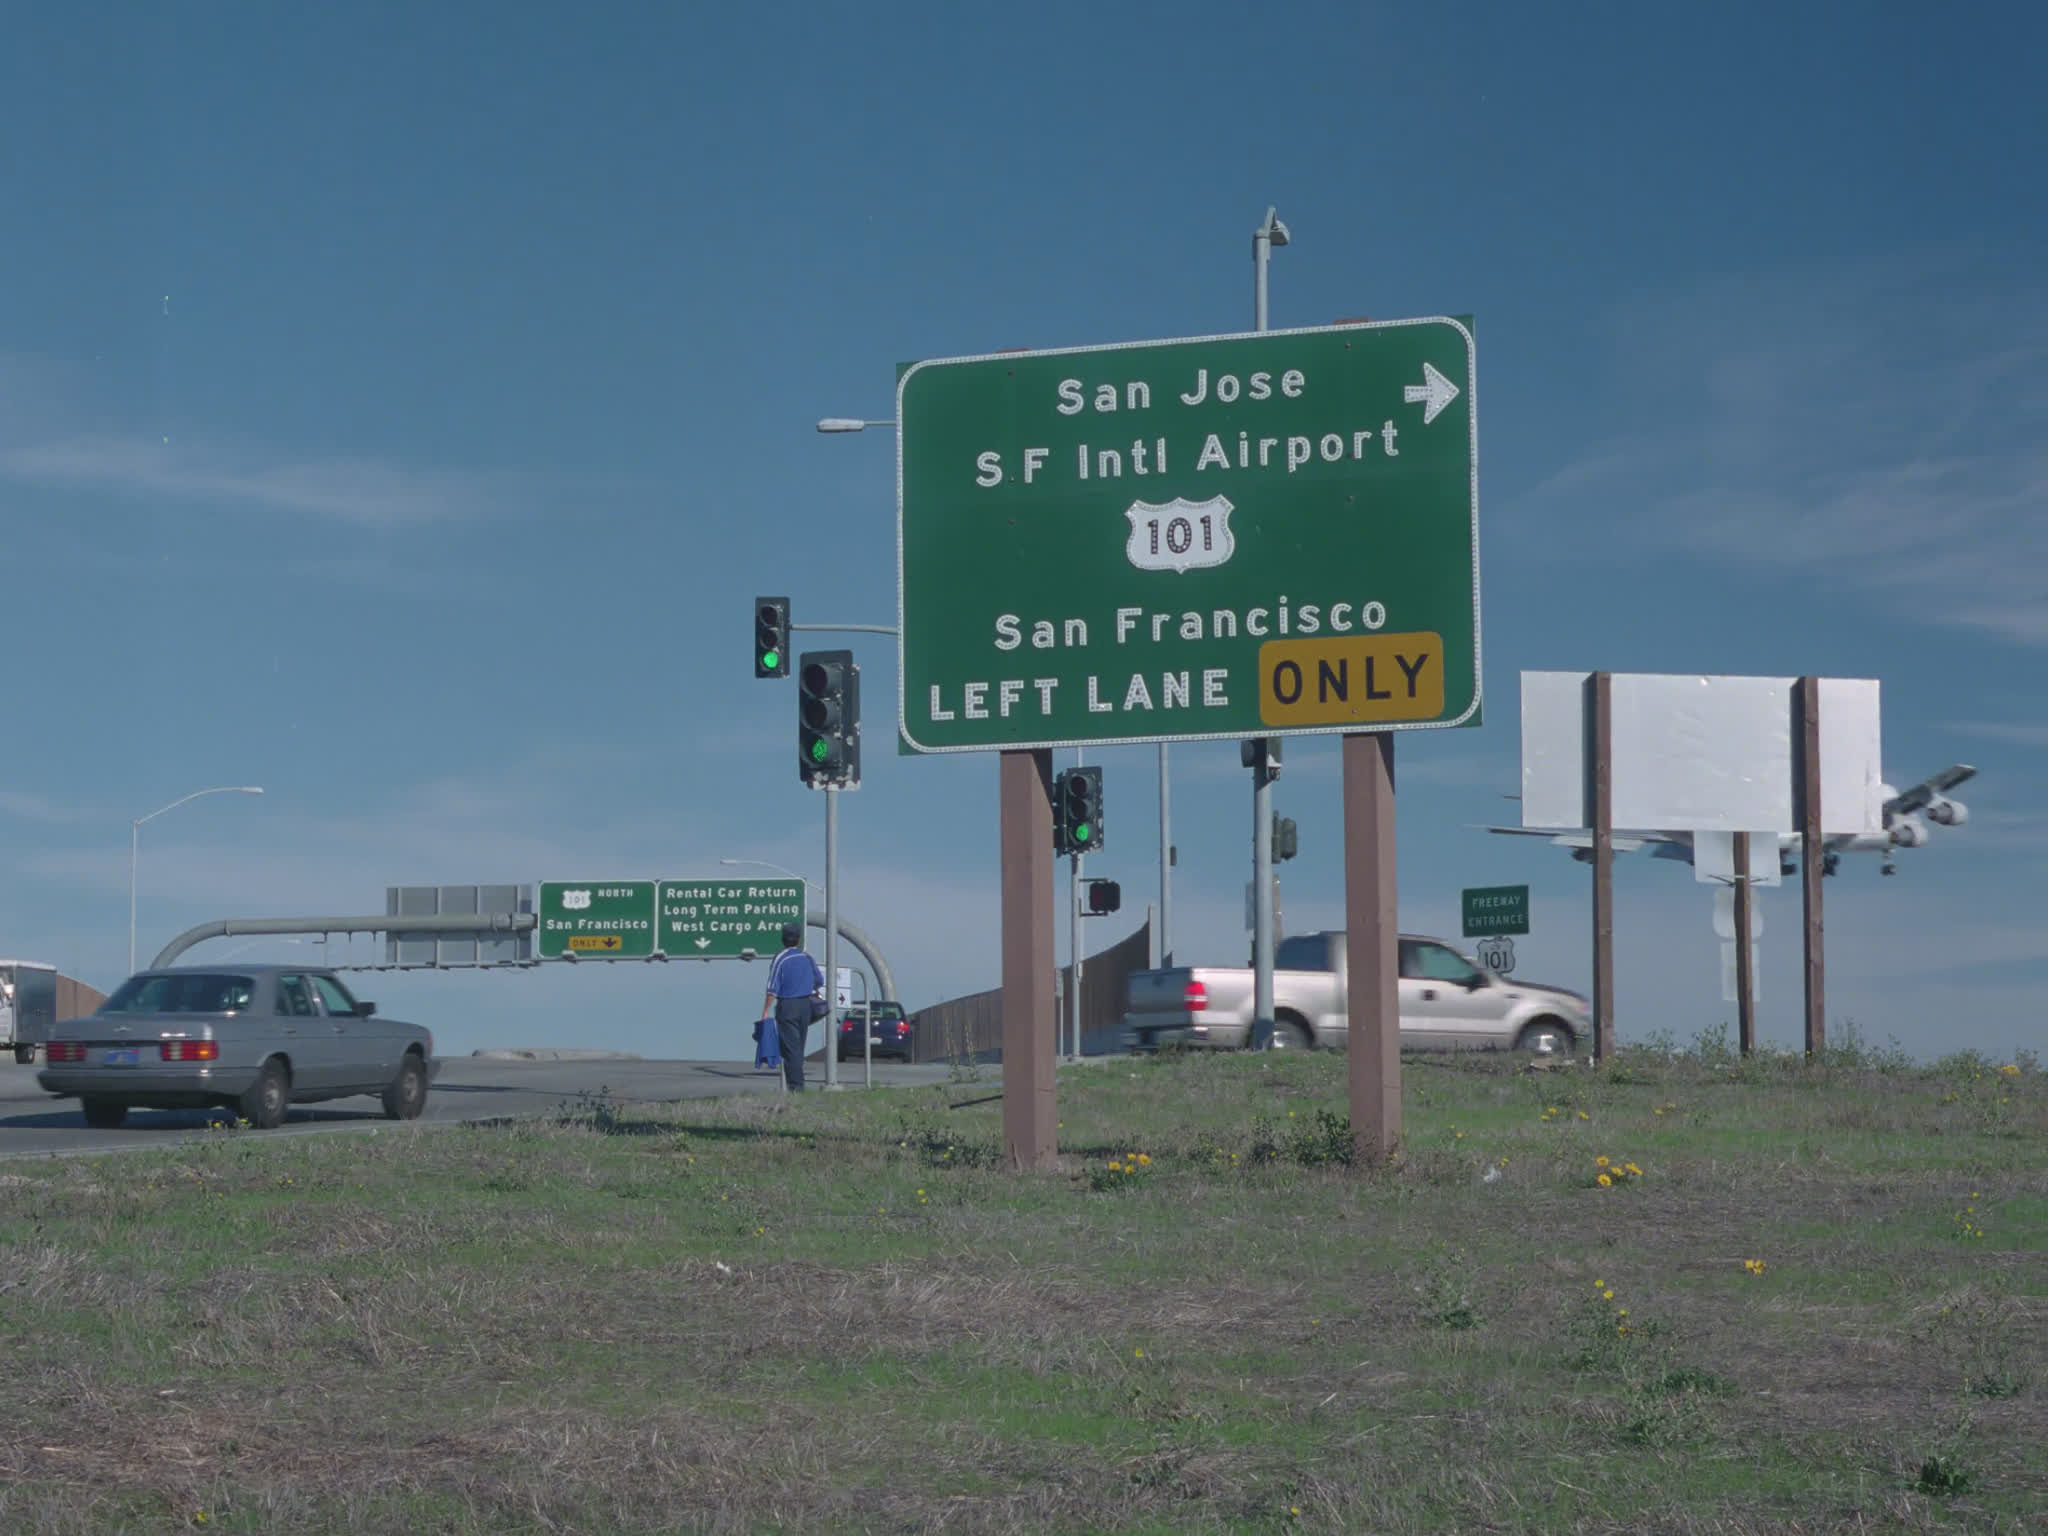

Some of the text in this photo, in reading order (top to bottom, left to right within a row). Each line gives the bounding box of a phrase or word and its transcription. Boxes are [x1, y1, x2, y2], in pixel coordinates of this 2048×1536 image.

[1057, 369, 1305, 414] San Jose
[976, 420, 1399, 487] S F Intl Airport
[1147, 514, 1212, 555] 101
[994, 596, 1386, 650] San Francisco
[1272, 653, 1429, 704] ONLY
[931, 669, 1228, 721] LEFT LANE
[597, 888, 634, 897] NORTH
[666, 887, 797, 898] Rental Car Return
[1471, 895, 1521, 908] FREEWAY
[664, 903, 799, 918] Long Term Parking
[546, 918, 648, 930] San Francisco
[671, 919, 787, 935] West Cargo Are
[1467, 913, 1524, 928] ENTRANCE
[1484, 951, 1508, 969] 101
